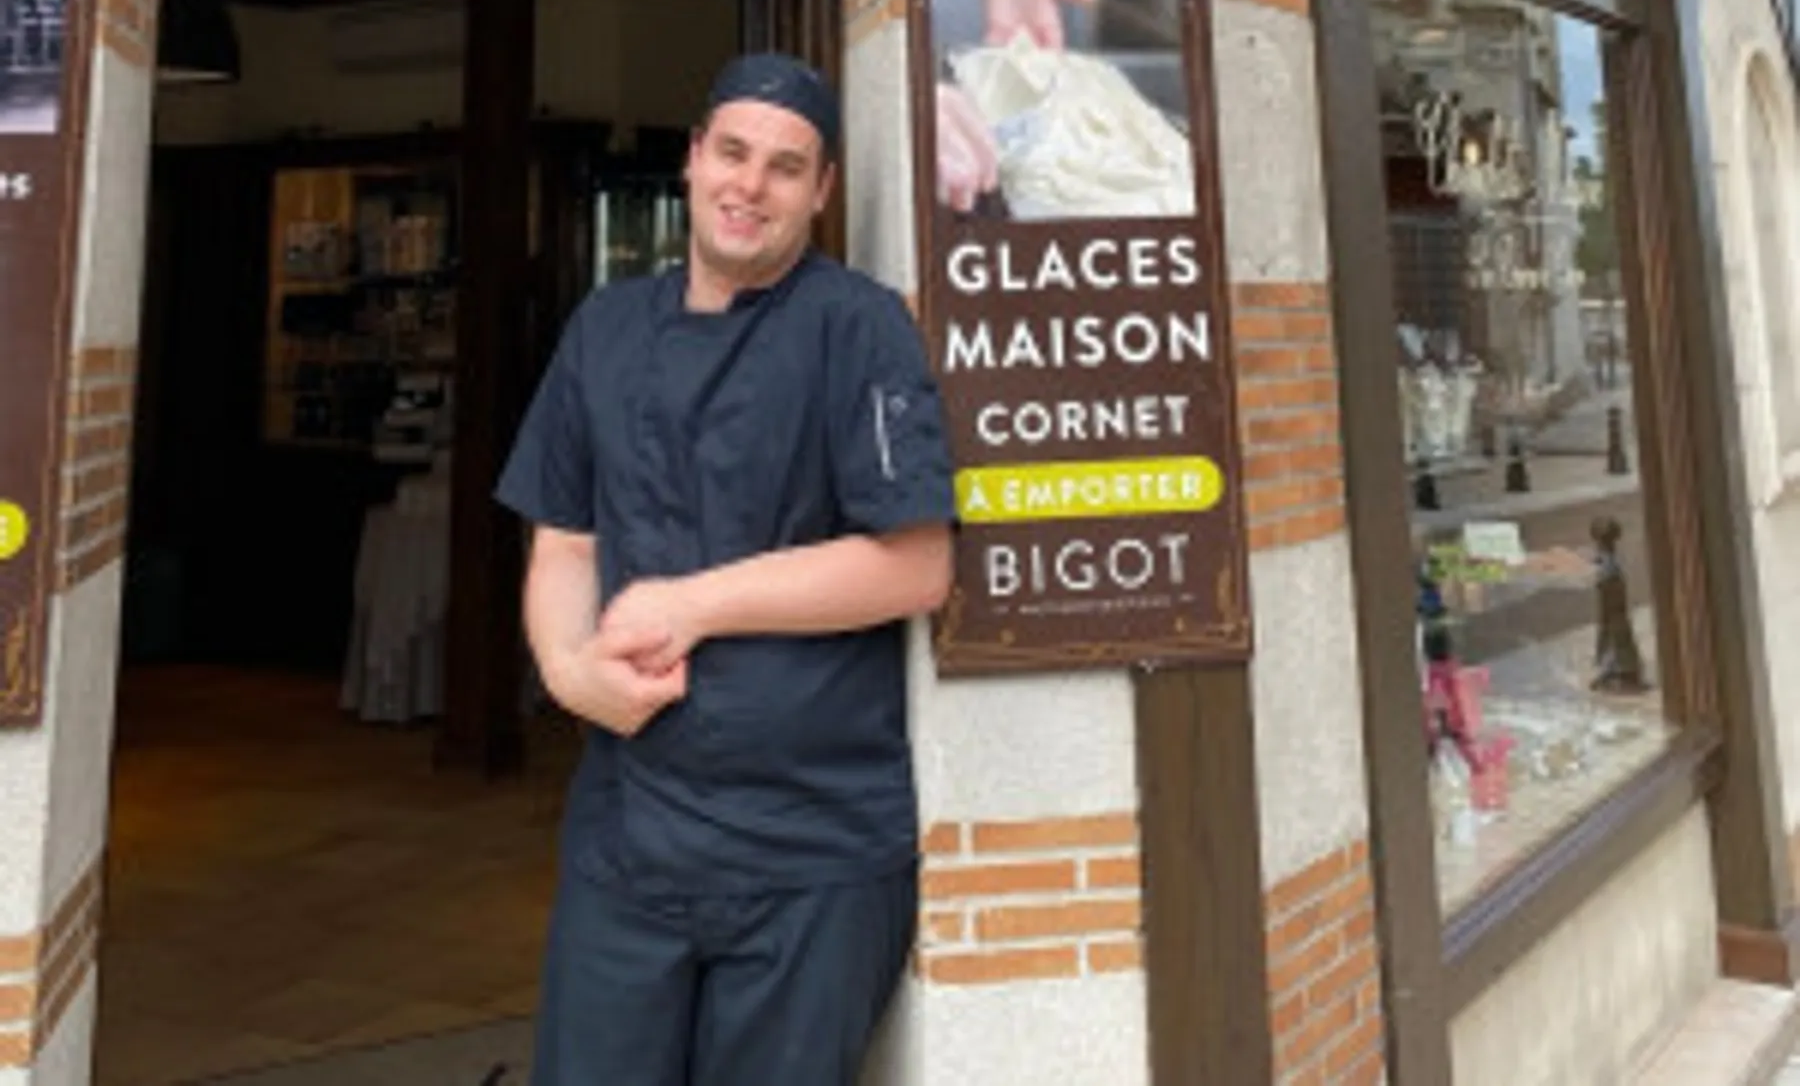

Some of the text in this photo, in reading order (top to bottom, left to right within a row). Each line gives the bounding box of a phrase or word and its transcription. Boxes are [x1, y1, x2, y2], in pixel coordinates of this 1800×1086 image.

[947, 237, 1200, 294] GLACES
[944, 312, 1213, 373] MAISON
[976, 394, 1190, 446] CORNET
[1002, 471, 1205, 512] EMPORTER
[986, 533, 1190, 597] BIGOT
